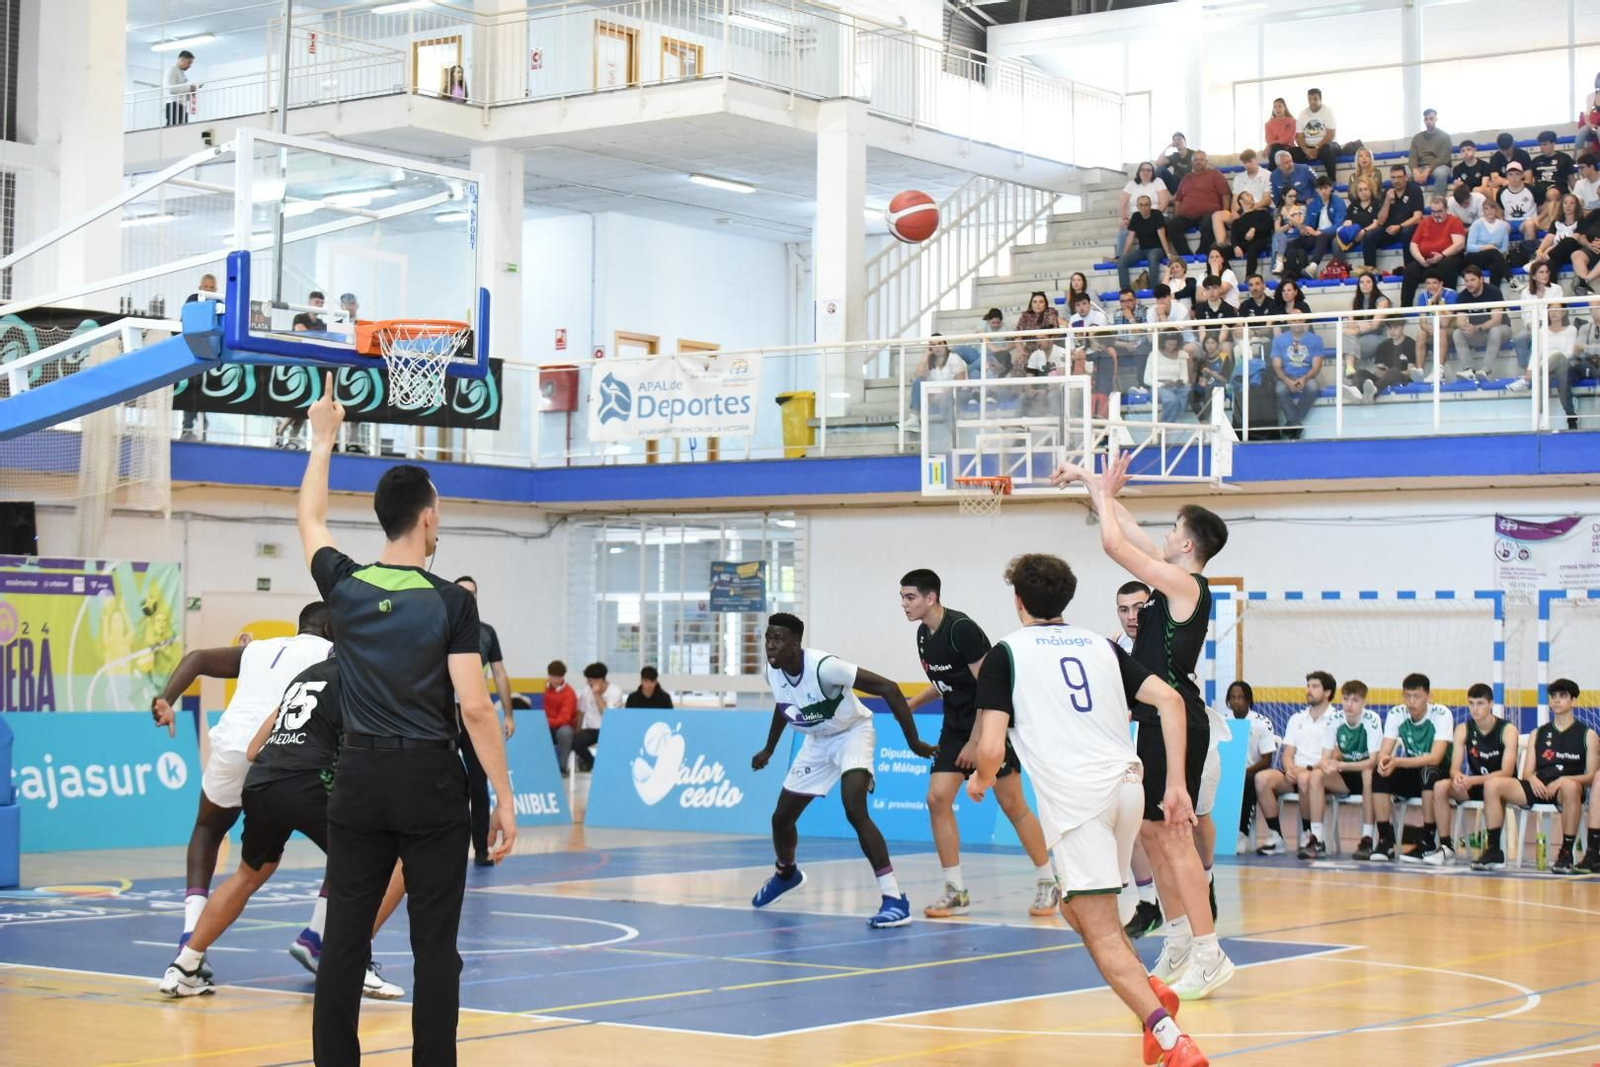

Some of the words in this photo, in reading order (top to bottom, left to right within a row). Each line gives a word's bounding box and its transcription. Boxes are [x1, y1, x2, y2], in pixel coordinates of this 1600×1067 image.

[638, 381, 667, 392] APAL
[670, 379, 684, 391] de
[637, 394, 751, 424] Deportes
[1035, 635, 1093, 647] málaga
[1060, 656, 1093, 713] 9
[272, 681, 328, 732] 15
[878, 762, 890, 772] de
[892, 761, 927, 775] Málaga
[680, 779, 744, 808] cesto
[874, 799, 884, 809] La
[888, 801, 924, 811] provincia
